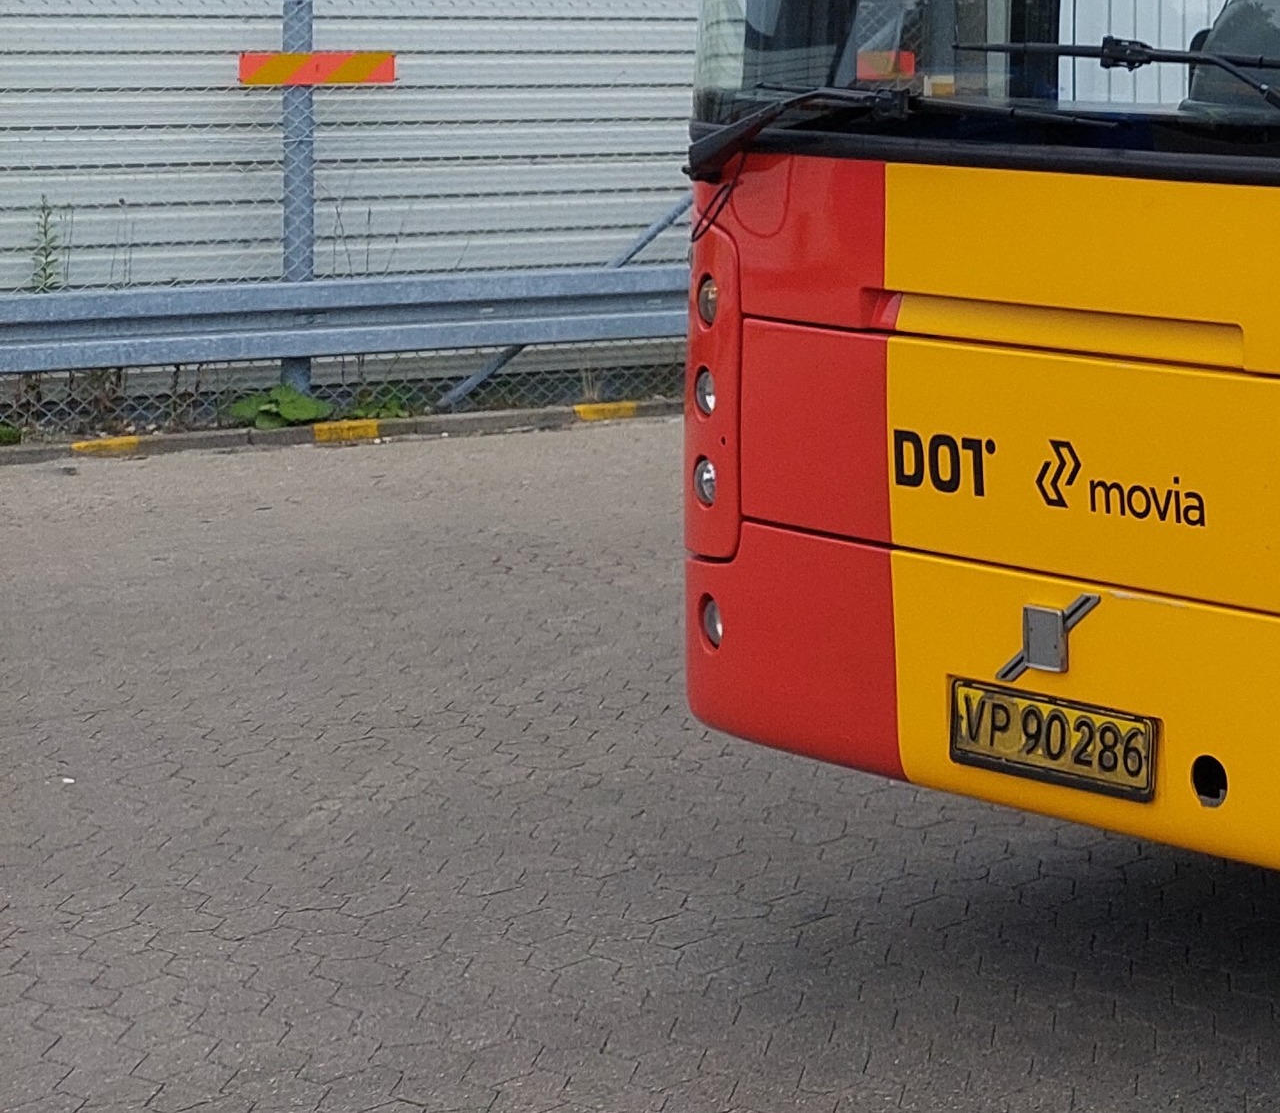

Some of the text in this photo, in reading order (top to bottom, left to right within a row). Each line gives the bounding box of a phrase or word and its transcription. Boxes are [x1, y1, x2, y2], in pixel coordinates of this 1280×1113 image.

[894, 429, 996, 497] DOT
[1089, 476, 1206, 527] movia
[963, 693, 1011, 747] VP
